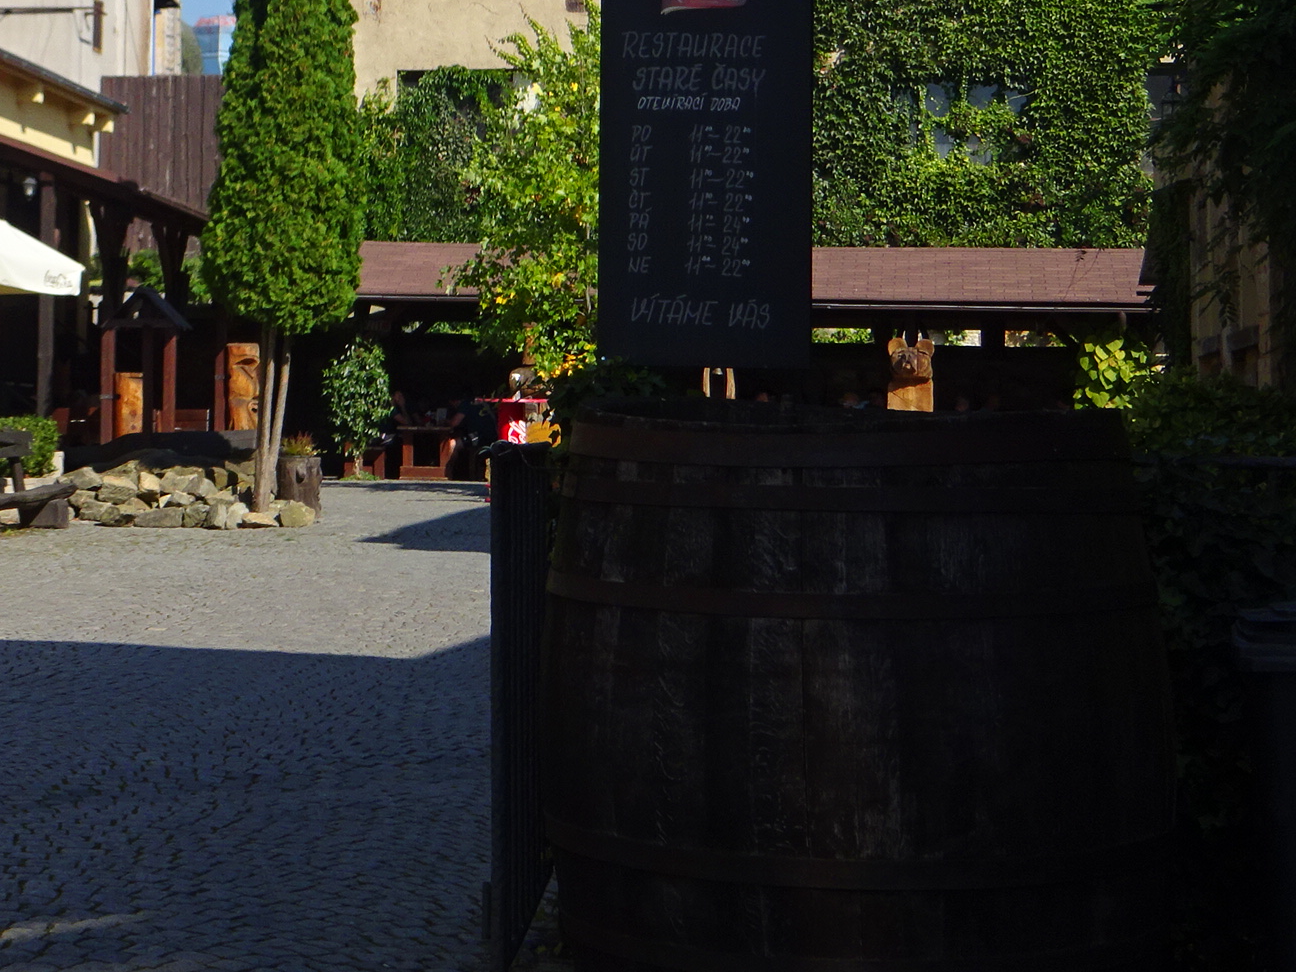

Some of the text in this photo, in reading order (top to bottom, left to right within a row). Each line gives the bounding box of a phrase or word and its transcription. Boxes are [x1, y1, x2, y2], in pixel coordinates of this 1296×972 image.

[621, 30, 767, 59] RESTAURACE
[632, 62, 767, 98] STARÉ ČASY
[637, 92, 742, 112] OTEVÍRACÍ DOBA
[631, 124, 653, 142] PO
[629, 143, 654, 162] ÚT
[629, 166, 651, 187] ST
[628, 189, 652, 209] ČT
[629, 206, 653, 230] PÁ
[627, 232, 649, 251] SO
[627, 255, 652, 274] NE
[630, 292, 771, 330] VÍTÁME VÁS
